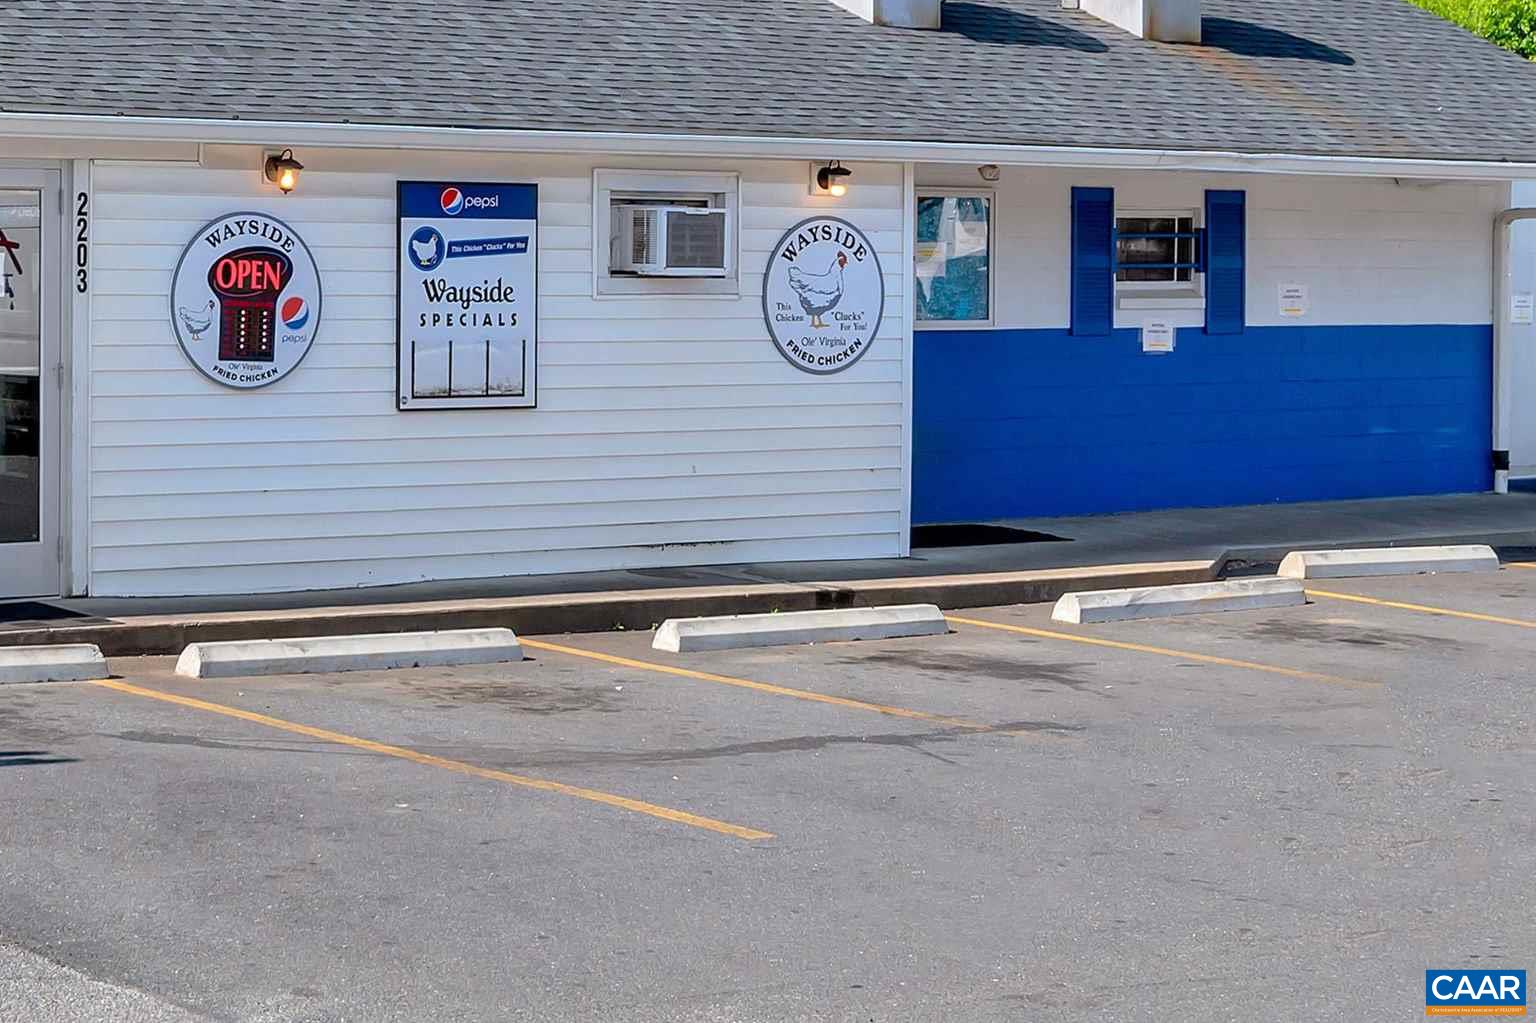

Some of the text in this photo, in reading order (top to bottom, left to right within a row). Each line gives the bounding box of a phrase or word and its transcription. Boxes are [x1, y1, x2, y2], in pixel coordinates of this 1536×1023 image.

[464, 194, 500, 209] pepsi
[205, 219, 295, 254] WAYSIDE
[781, 225, 867, 263] WAYSIDE
[216, 257, 282, 291] OPEN
[421, 277, 516, 310] Wayside
[776, 302, 792, 311] This
[420, 313, 519, 327] SPECIALS
[281, 334, 307, 344] pepsi
[818, 336, 846, 348] Virginia
[786, 338, 862, 366] FRIED CHICKEN
[213, 365, 279, 383] FRIED CHICKEN
